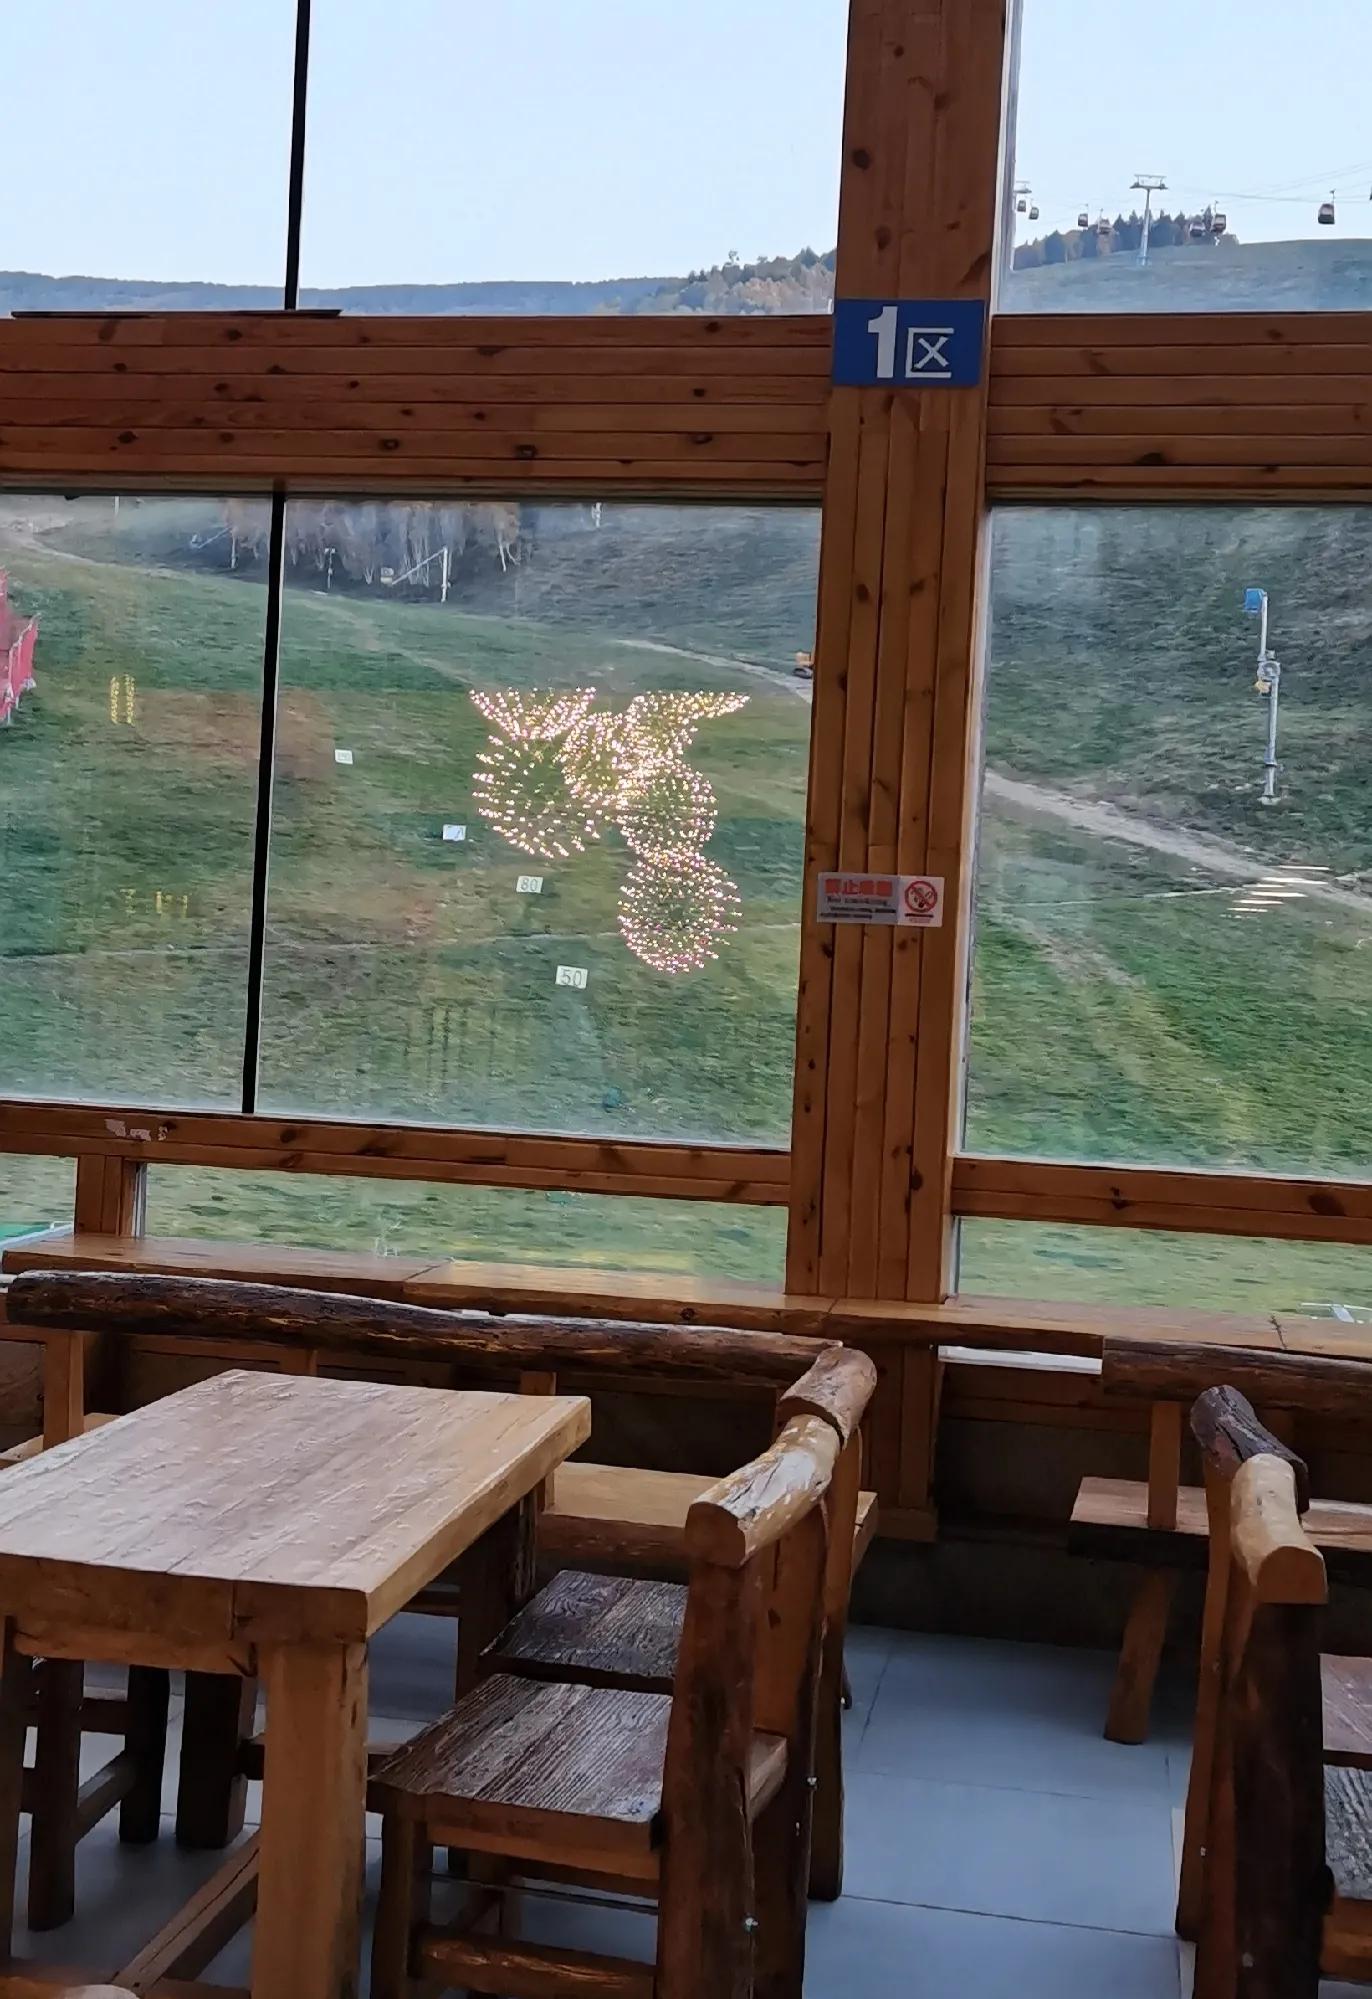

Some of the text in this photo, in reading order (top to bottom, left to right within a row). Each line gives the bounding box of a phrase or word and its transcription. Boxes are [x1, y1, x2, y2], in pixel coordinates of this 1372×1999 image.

[867, 305, 955, 379] 1区
[520, 877, 539, 892] 80
[560, 968, 582, 987] 50
